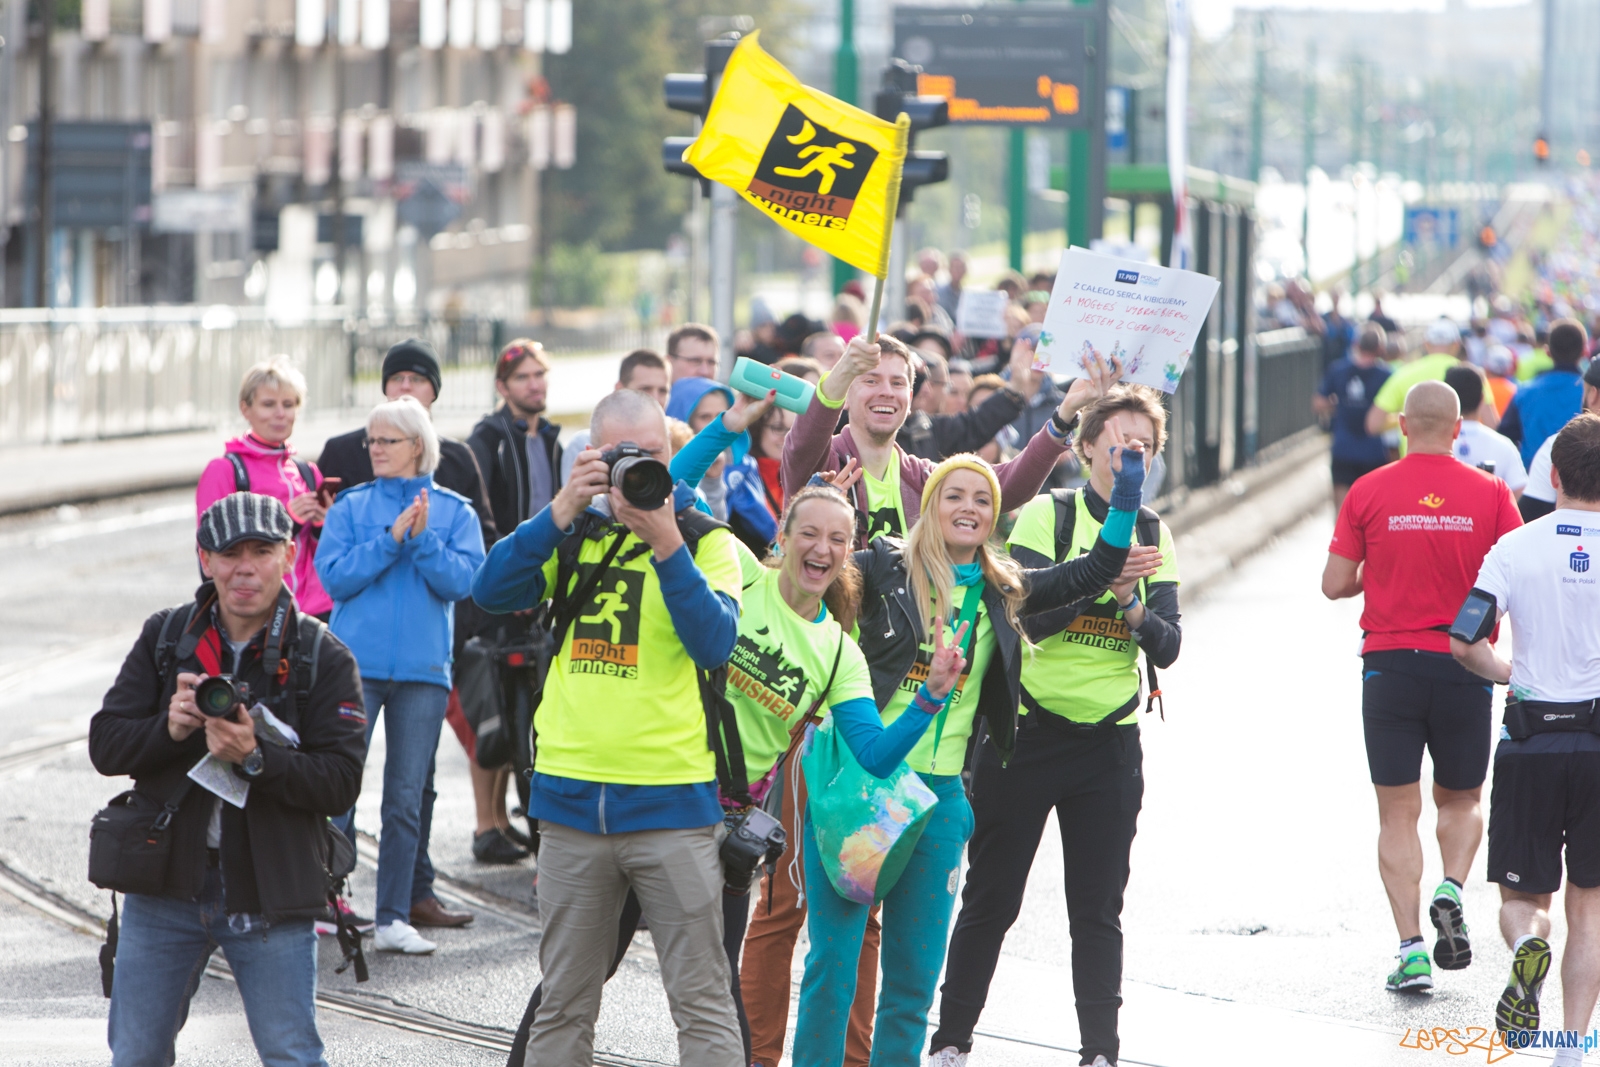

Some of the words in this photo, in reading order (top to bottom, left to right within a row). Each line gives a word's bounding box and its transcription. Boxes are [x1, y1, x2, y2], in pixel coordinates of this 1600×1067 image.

[746, 190, 847, 230] runners
[769, 188, 837, 211] night
[1063, 295, 1072, 305] A
[1073, 282, 1080, 290] Z
[1081, 283, 1115, 296] CAŁEGO
[1116, 290, 1142, 301] SERCA
[1144, 295, 1188, 307] KIBICUJEMY
[1388, 514, 1438, 525] SPORTOWA
[1440, 515, 1474, 526] PACZKA
[1388, 523, 1423, 532] POCZTOWA
[1423, 523, 1444, 531] GRUPA
[1444, 523, 1474, 533] BIEGOWA
[271, 606, 286, 637] SONY
[1081, 617, 1127, 635] night
[578, 639, 626, 660] night
[1063, 631, 1130, 653] runners
[729, 651, 768, 681] runners
[734, 644, 760, 666] night
[568, 659, 638, 680] runners
[727, 665, 795, 722] INISHER
